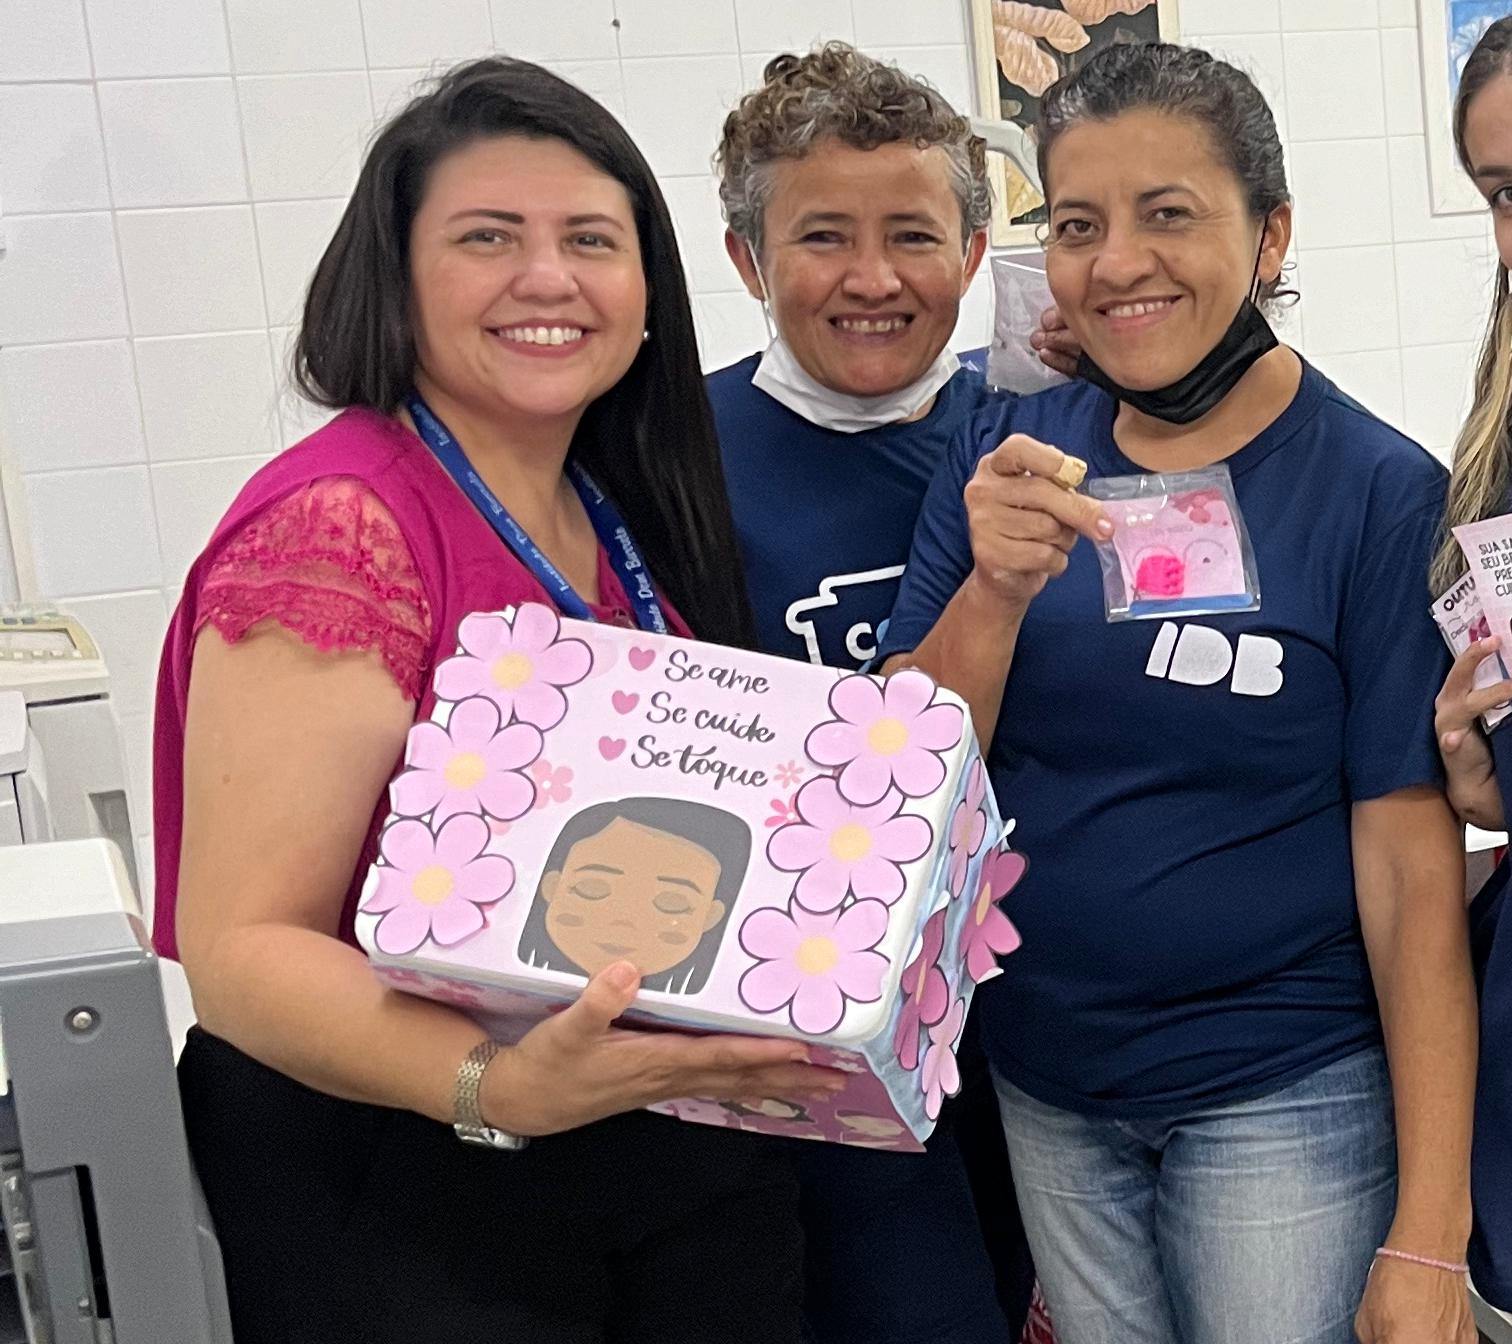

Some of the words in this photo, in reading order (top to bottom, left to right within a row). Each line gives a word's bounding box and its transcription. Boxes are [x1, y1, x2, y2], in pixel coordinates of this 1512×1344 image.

[1478, 541, 1501, 555] SUA
[1480, 555, 1500, 570] SEU
[1443, 576, 1476, 611] OUTU
[664, 649, 704, 682] Se
[708, 666, 770, 694] ame
[1145, 621, 1284, 696] IDB
[646, 691, 688, 724] Se
[694, 709, 775, 743] cuide
[631, 734, 673, 769] Se
[673, 744, 769, 791] toque
